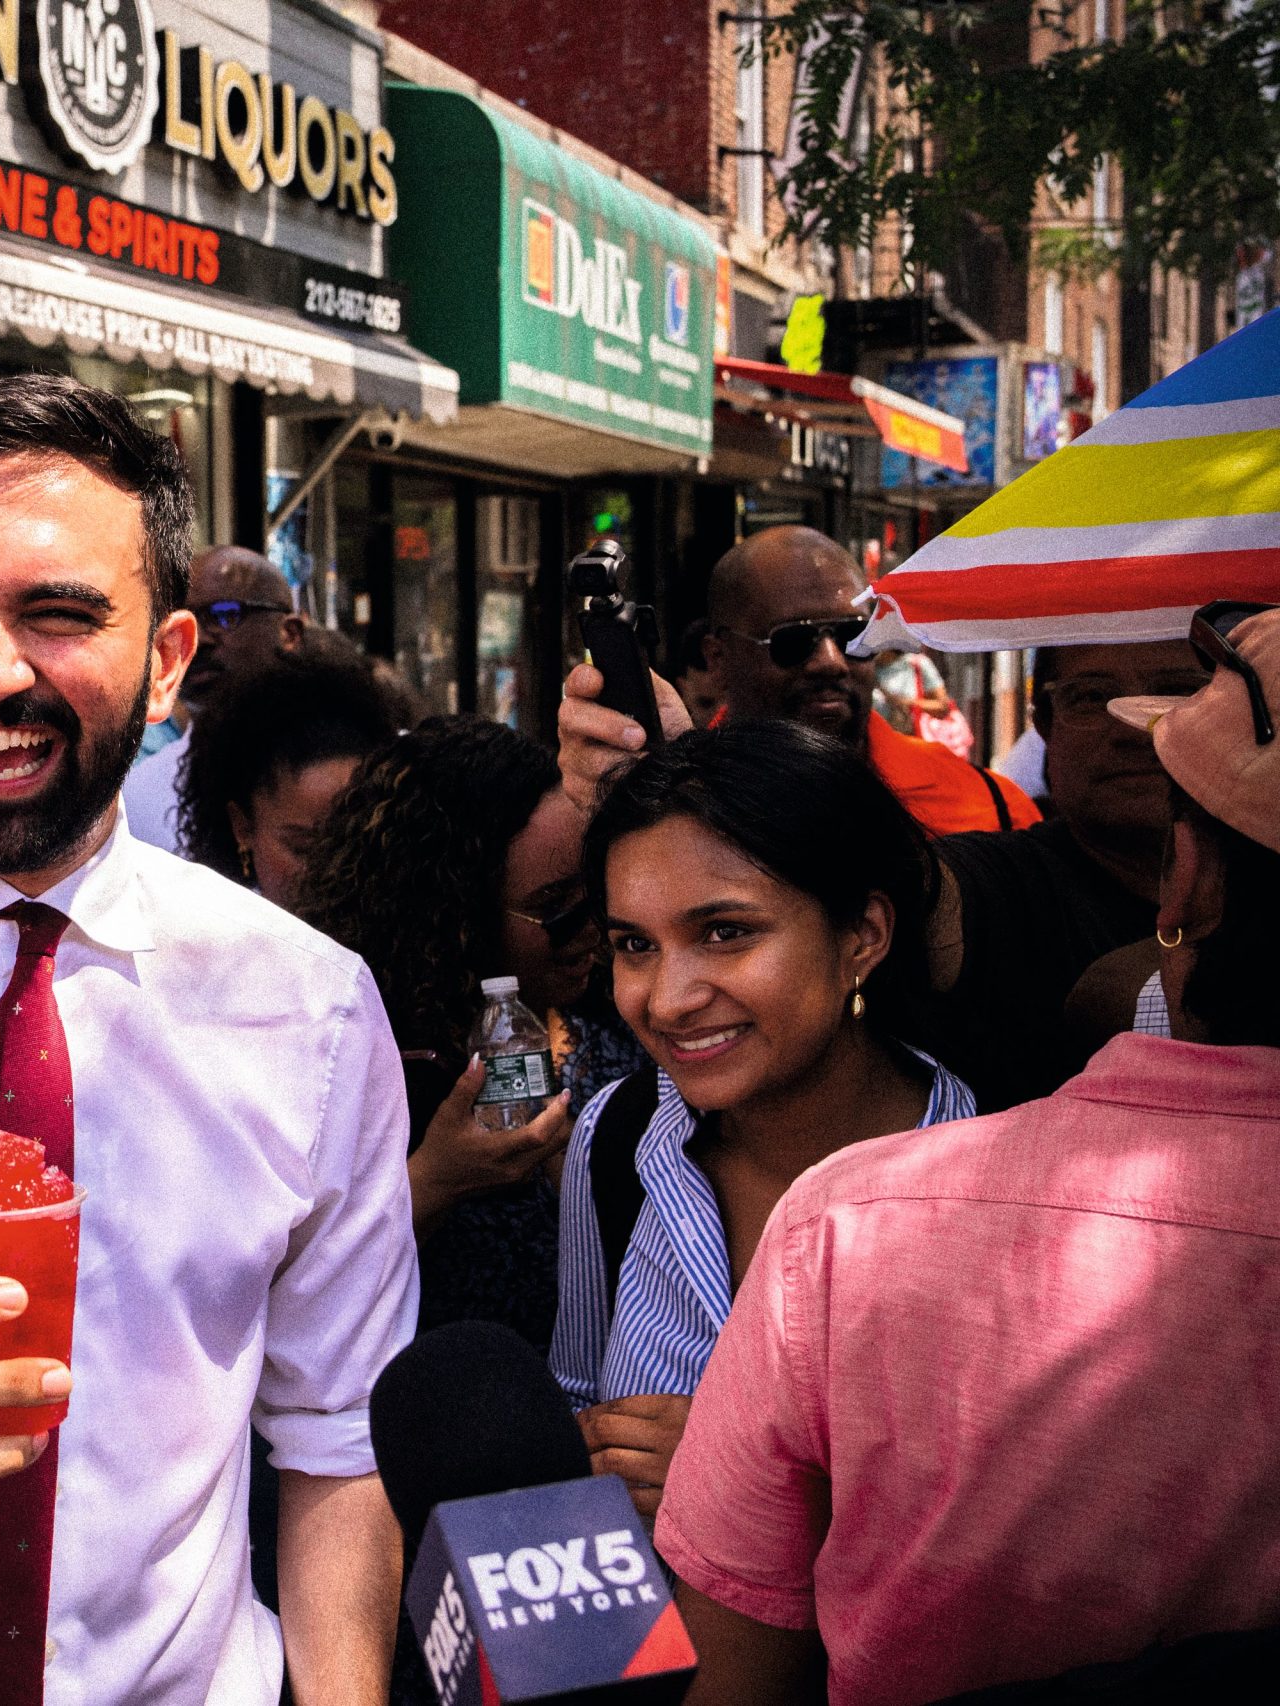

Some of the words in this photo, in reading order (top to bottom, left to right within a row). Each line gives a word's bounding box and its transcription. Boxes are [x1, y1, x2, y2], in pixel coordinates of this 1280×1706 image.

[164, 29, 398, 227] LIQUORS
[53, 185, 84, 251] &
[87, 195, 221, 287] SPIRITS
[104, 306, 163, 353] PRICE
[174, 325, 210, 365] ALL
[467, 1536, 604, 1611] FOX
[594, 1528, 647, 1586] 5
[486, 1600, 558, 1631] NEW
[569, 1582, 658, 1616] YORK
[423, 1592, 461, 1695] FOX
[442, 1570, 467, 1634] 5
